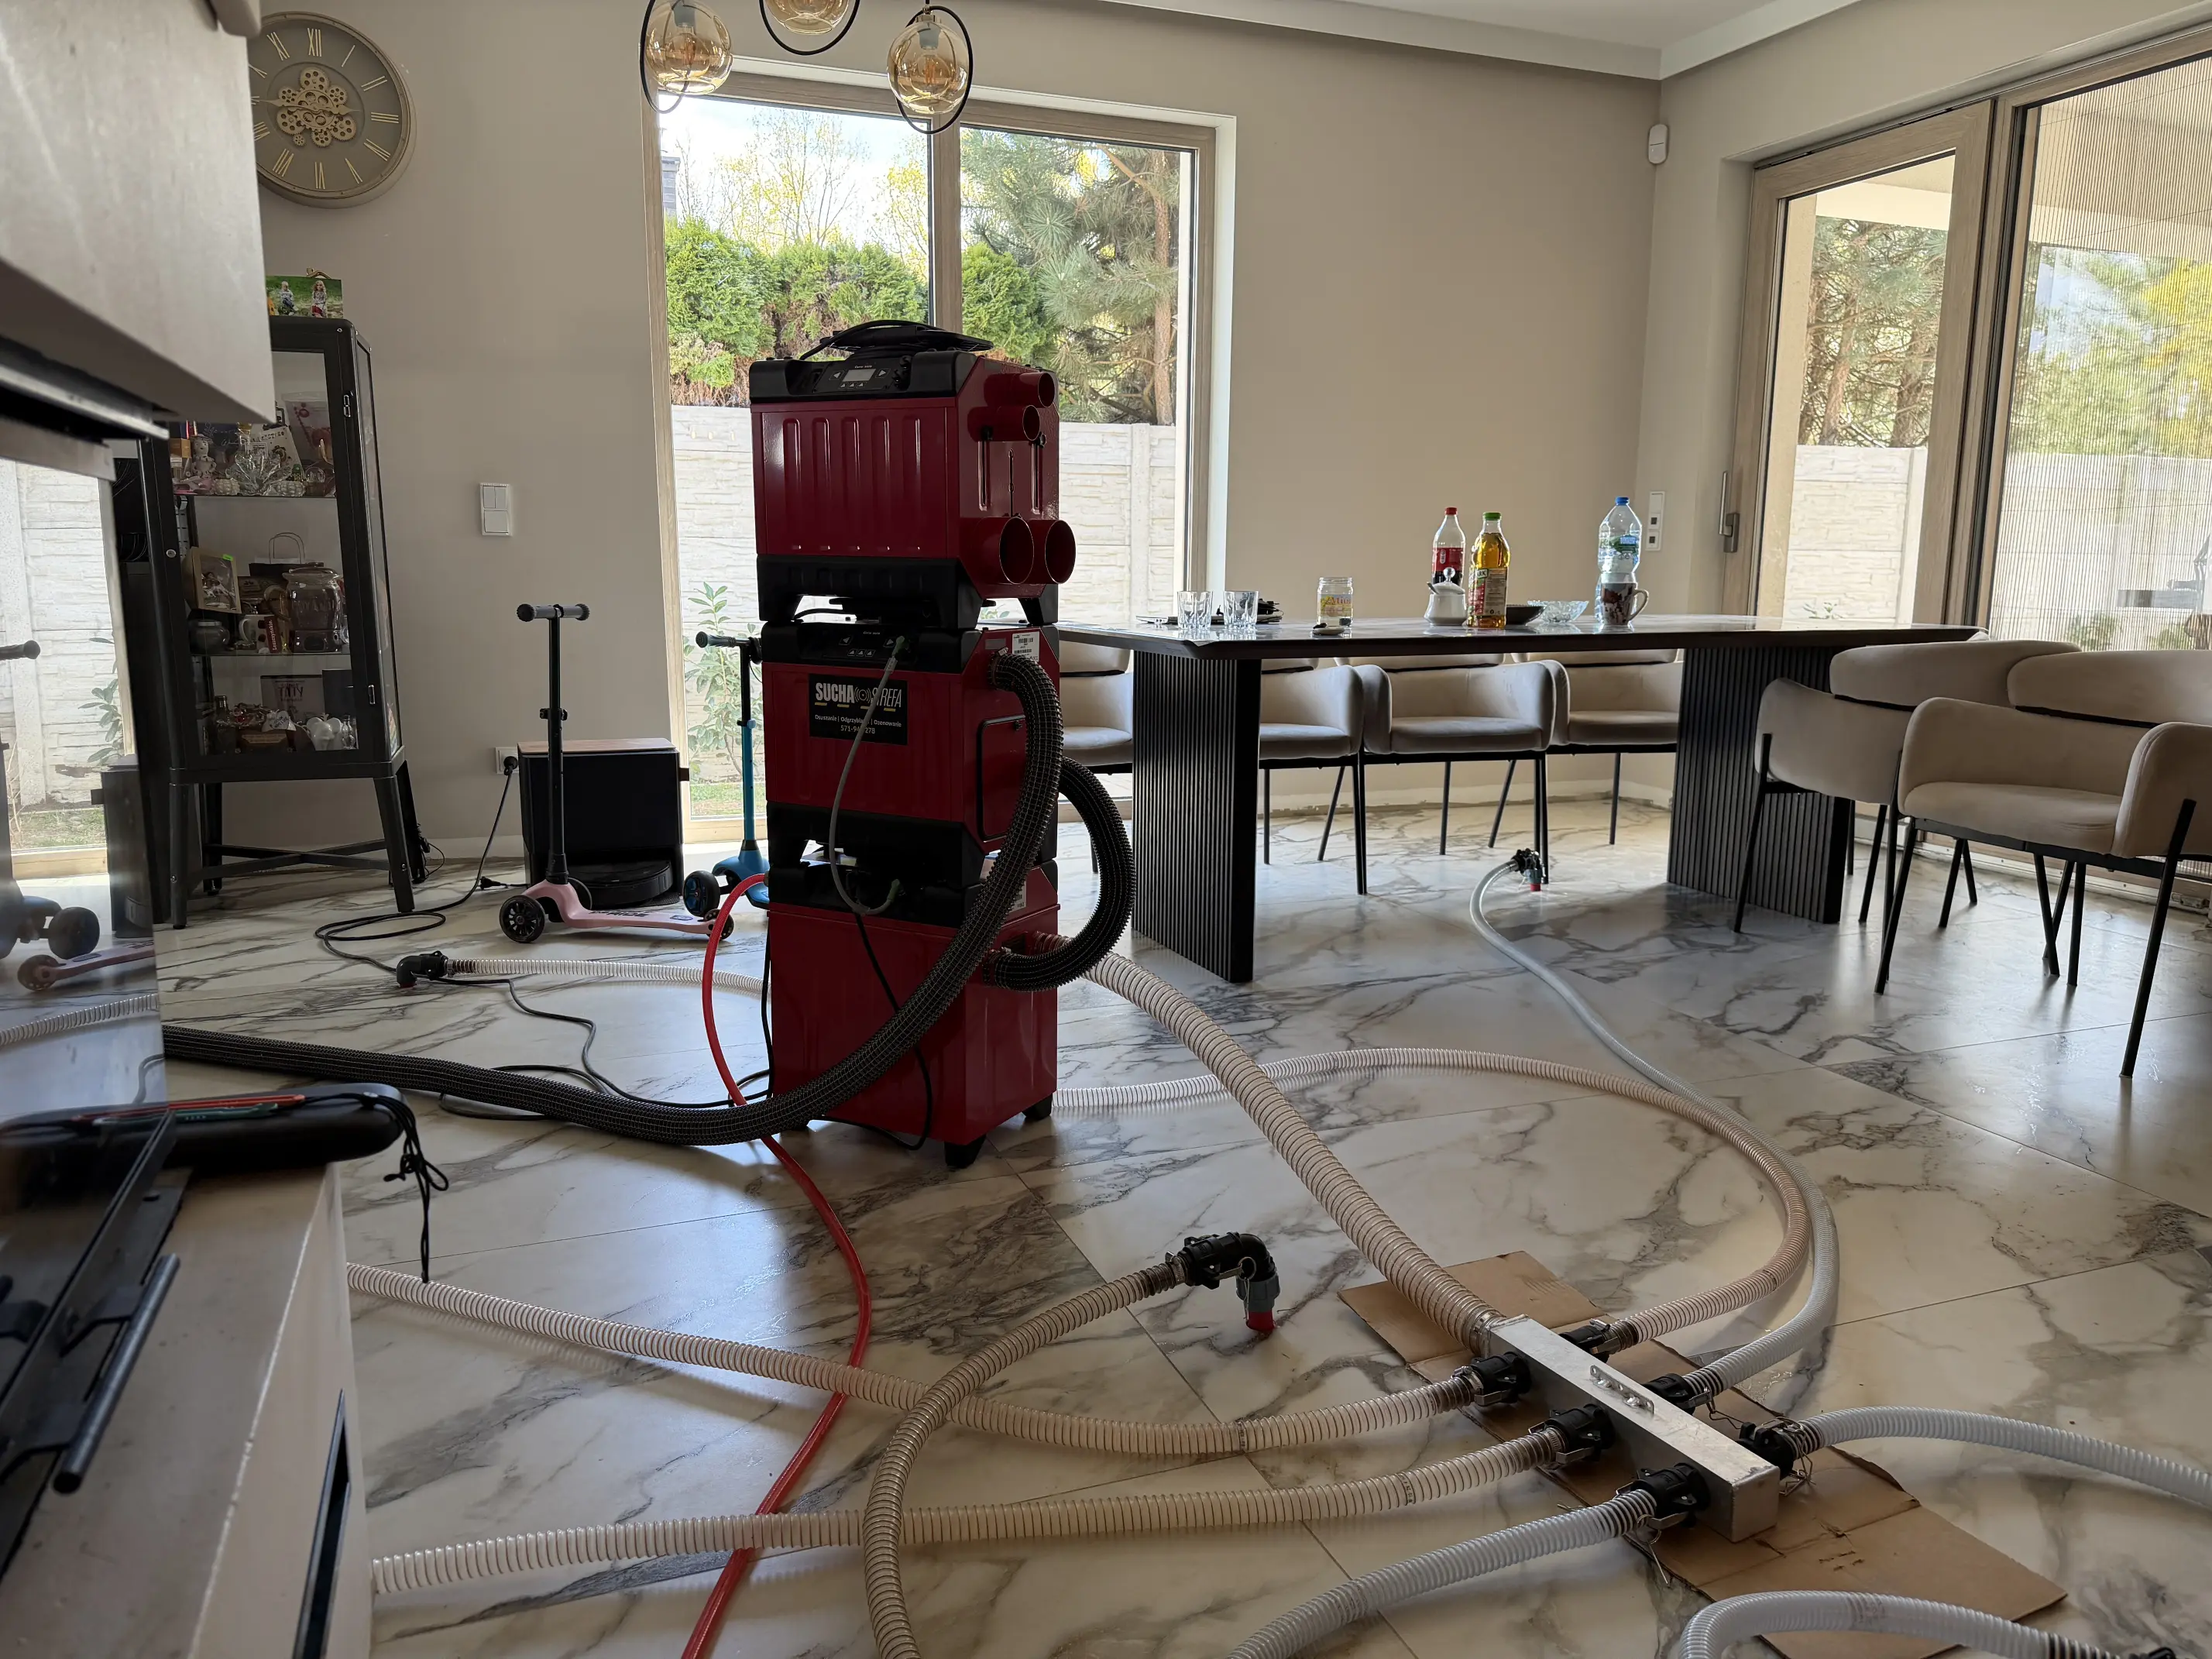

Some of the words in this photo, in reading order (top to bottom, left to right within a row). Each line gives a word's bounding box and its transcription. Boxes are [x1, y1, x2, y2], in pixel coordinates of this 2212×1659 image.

[307, 28, 322, 57] XII
[815, 682, 855, 703] SUCHA
[870, 687, 902, 708] SREFA
